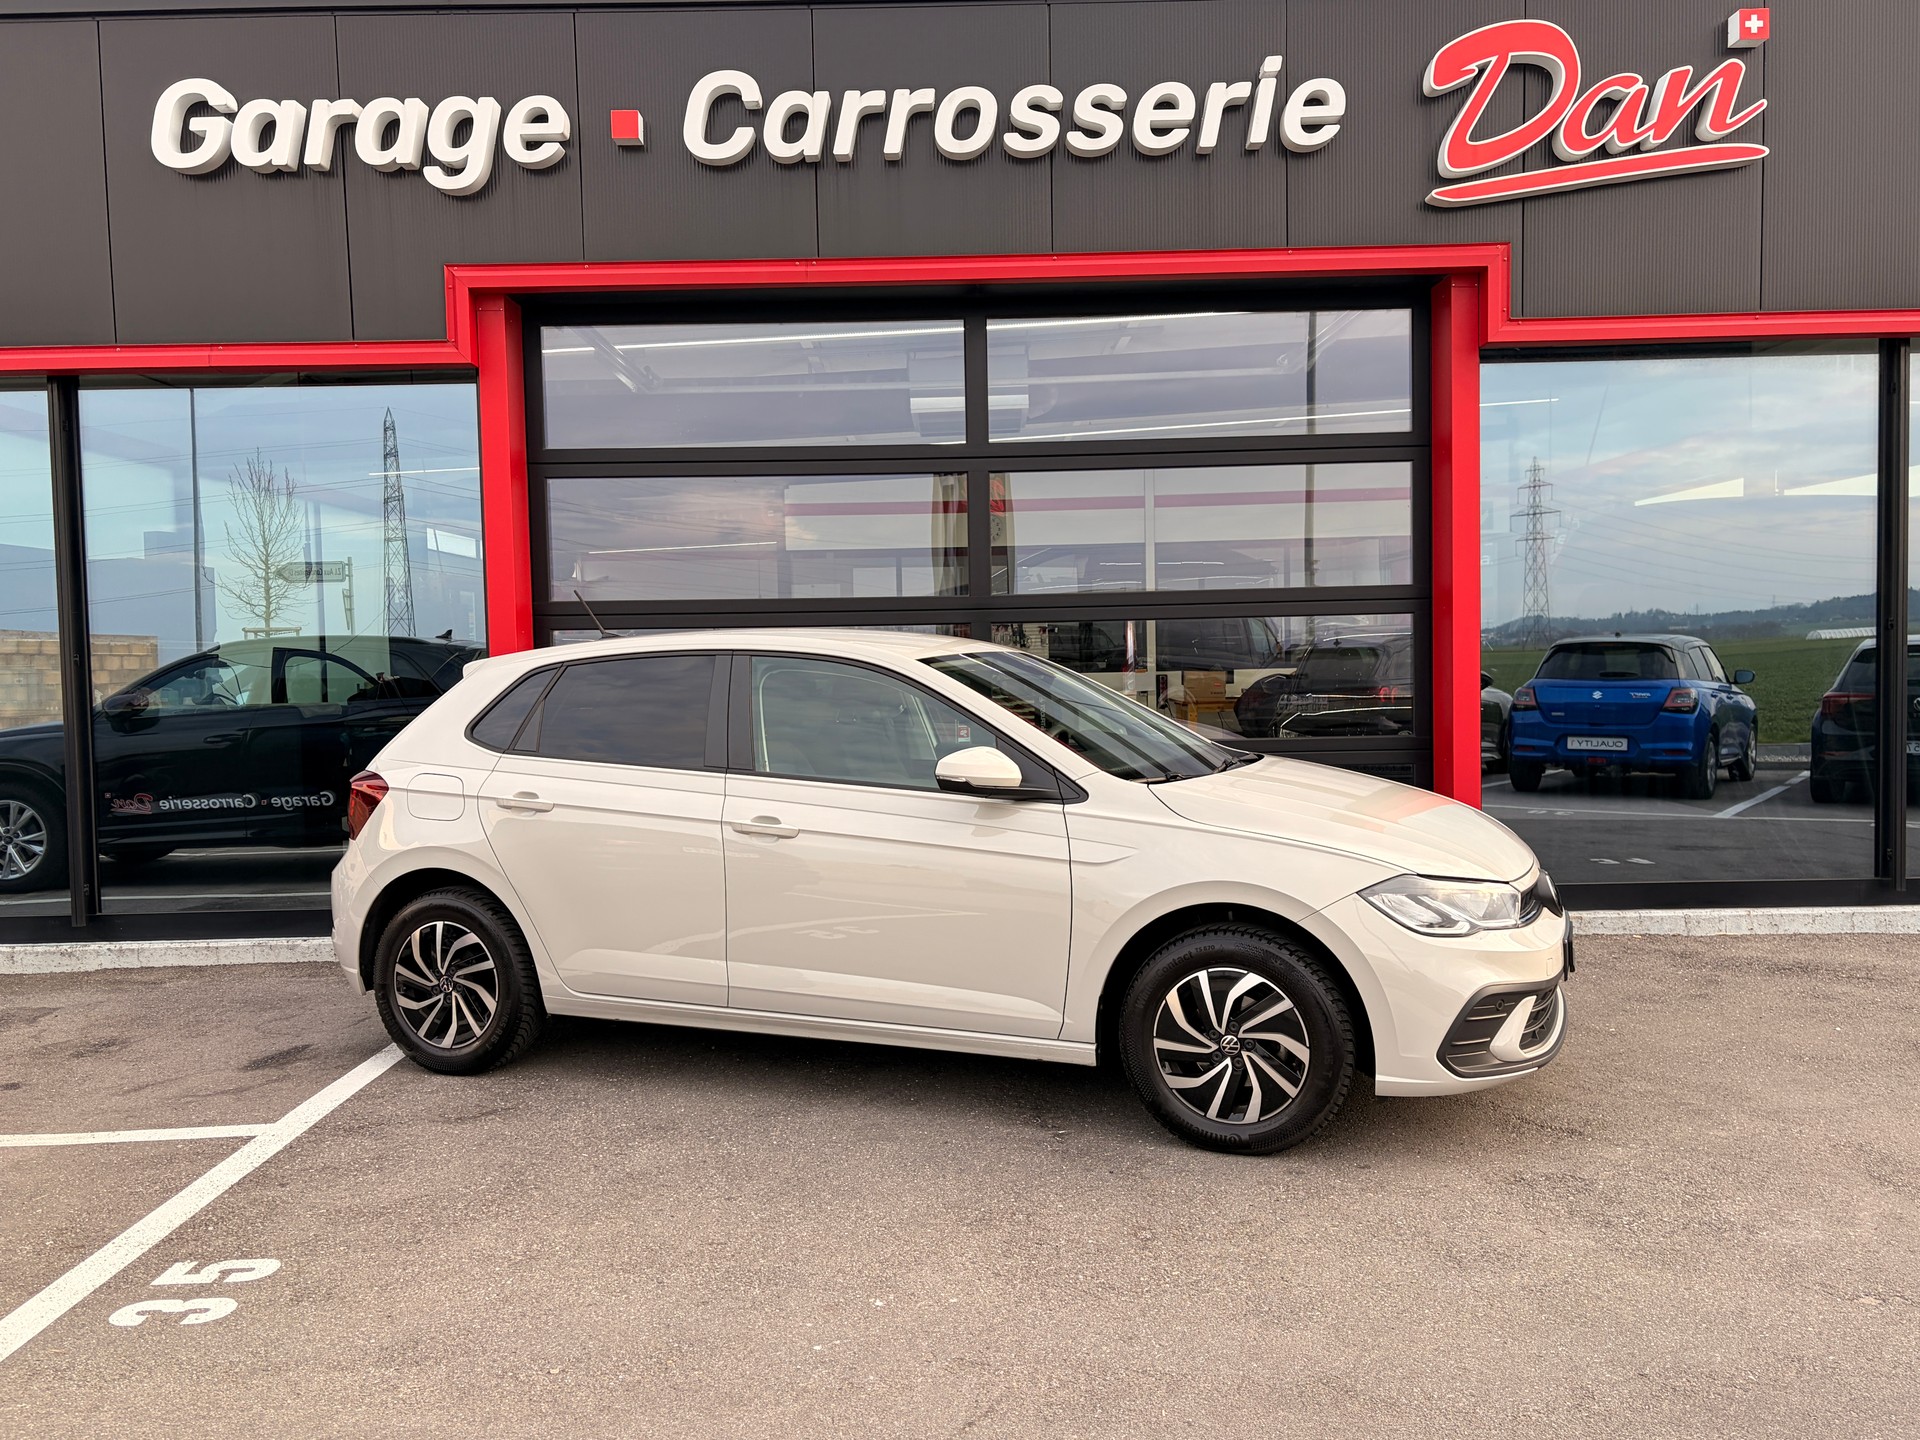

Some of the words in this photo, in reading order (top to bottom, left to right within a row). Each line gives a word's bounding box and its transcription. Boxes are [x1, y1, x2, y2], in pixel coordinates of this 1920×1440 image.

[151, 78, 570, 196] Garage
[682, 55, 1347, 165] Carrosserie
[109, 1258, 282, 1326] 35
